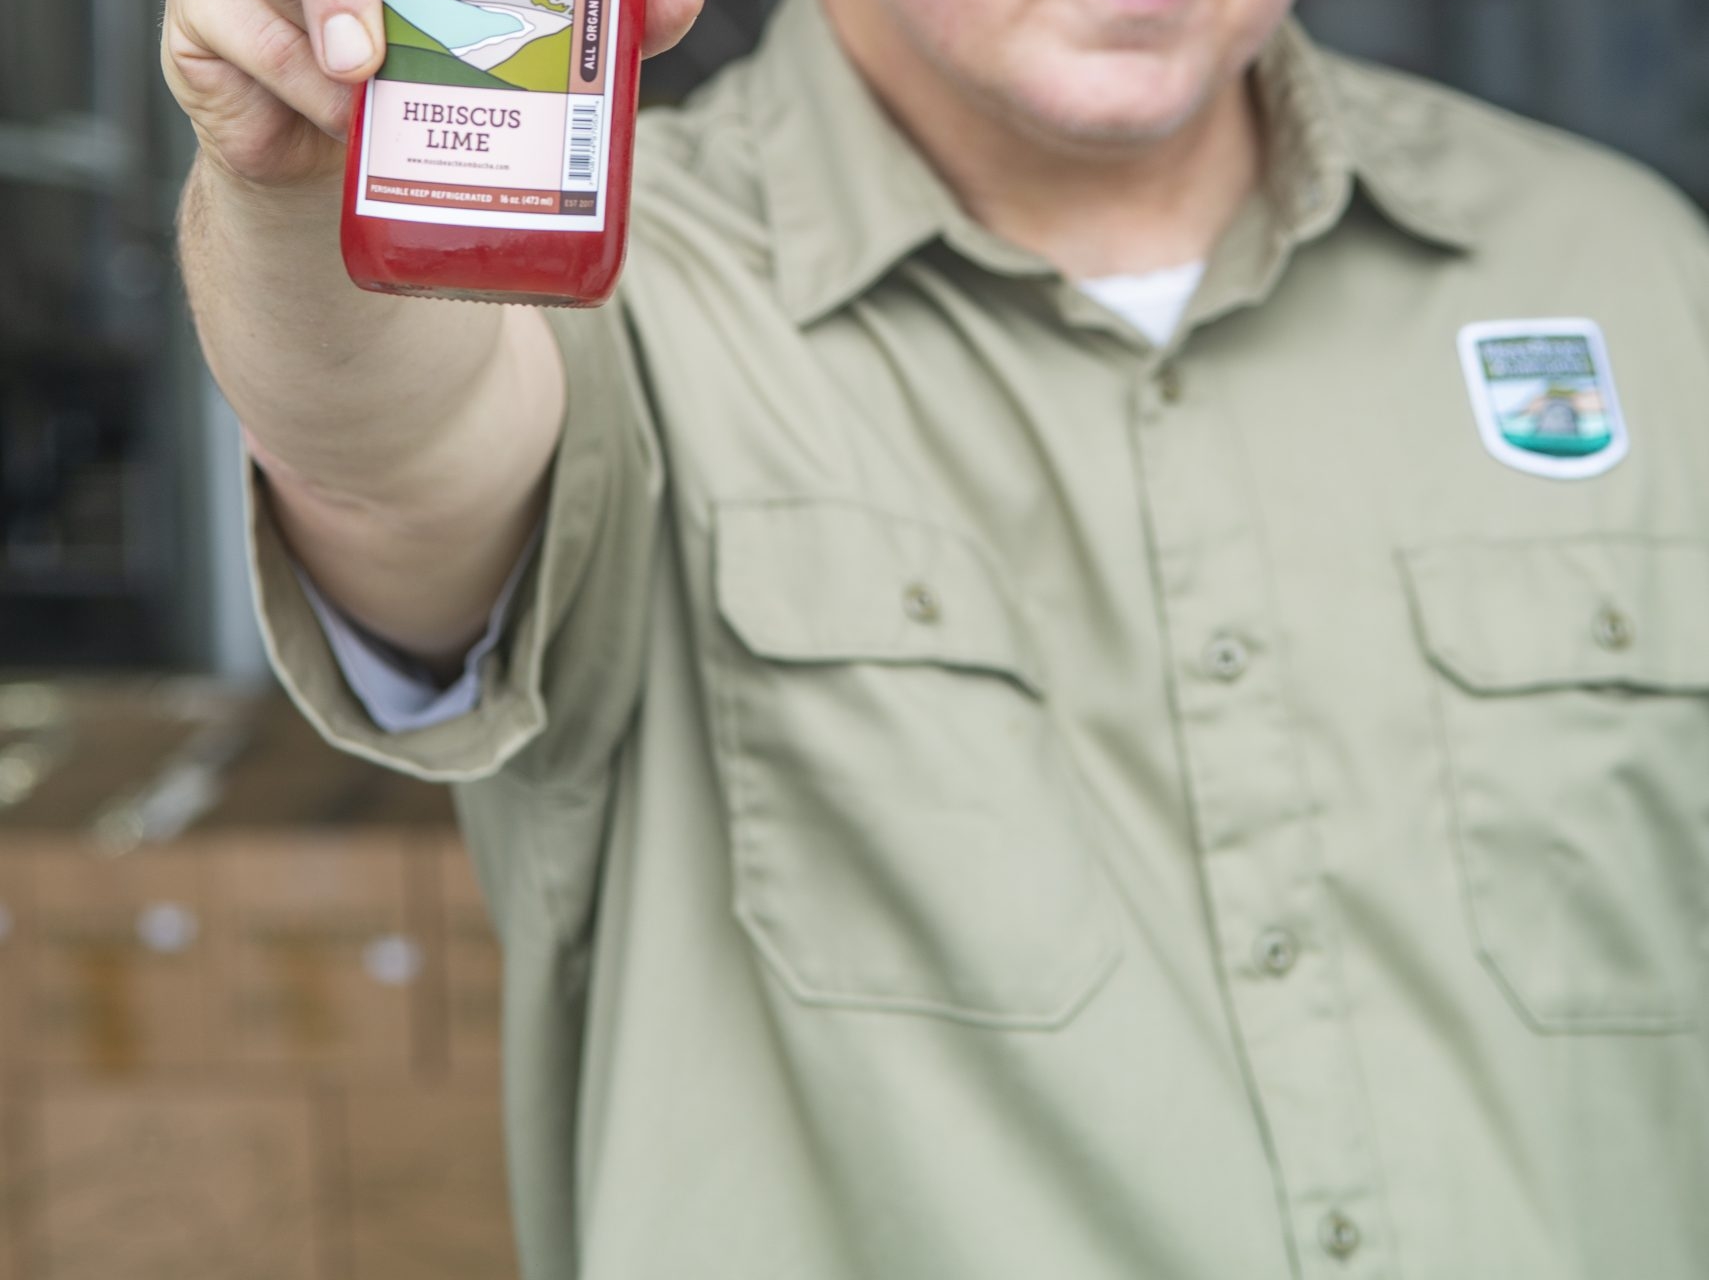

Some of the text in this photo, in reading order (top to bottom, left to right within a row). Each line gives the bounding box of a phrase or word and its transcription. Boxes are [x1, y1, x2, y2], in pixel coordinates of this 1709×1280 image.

[584, 46, 597, 70] ALL
[403, 101, 521, 129] HIBISCUS
[426, 129, 490, 152] LIME
[409, 188, 430, 198] KEEP
[431, 190, 493, 203] REFRIGERATED
[500, 194, 508, 204] 16
[564, 199, 578, 208] EST
